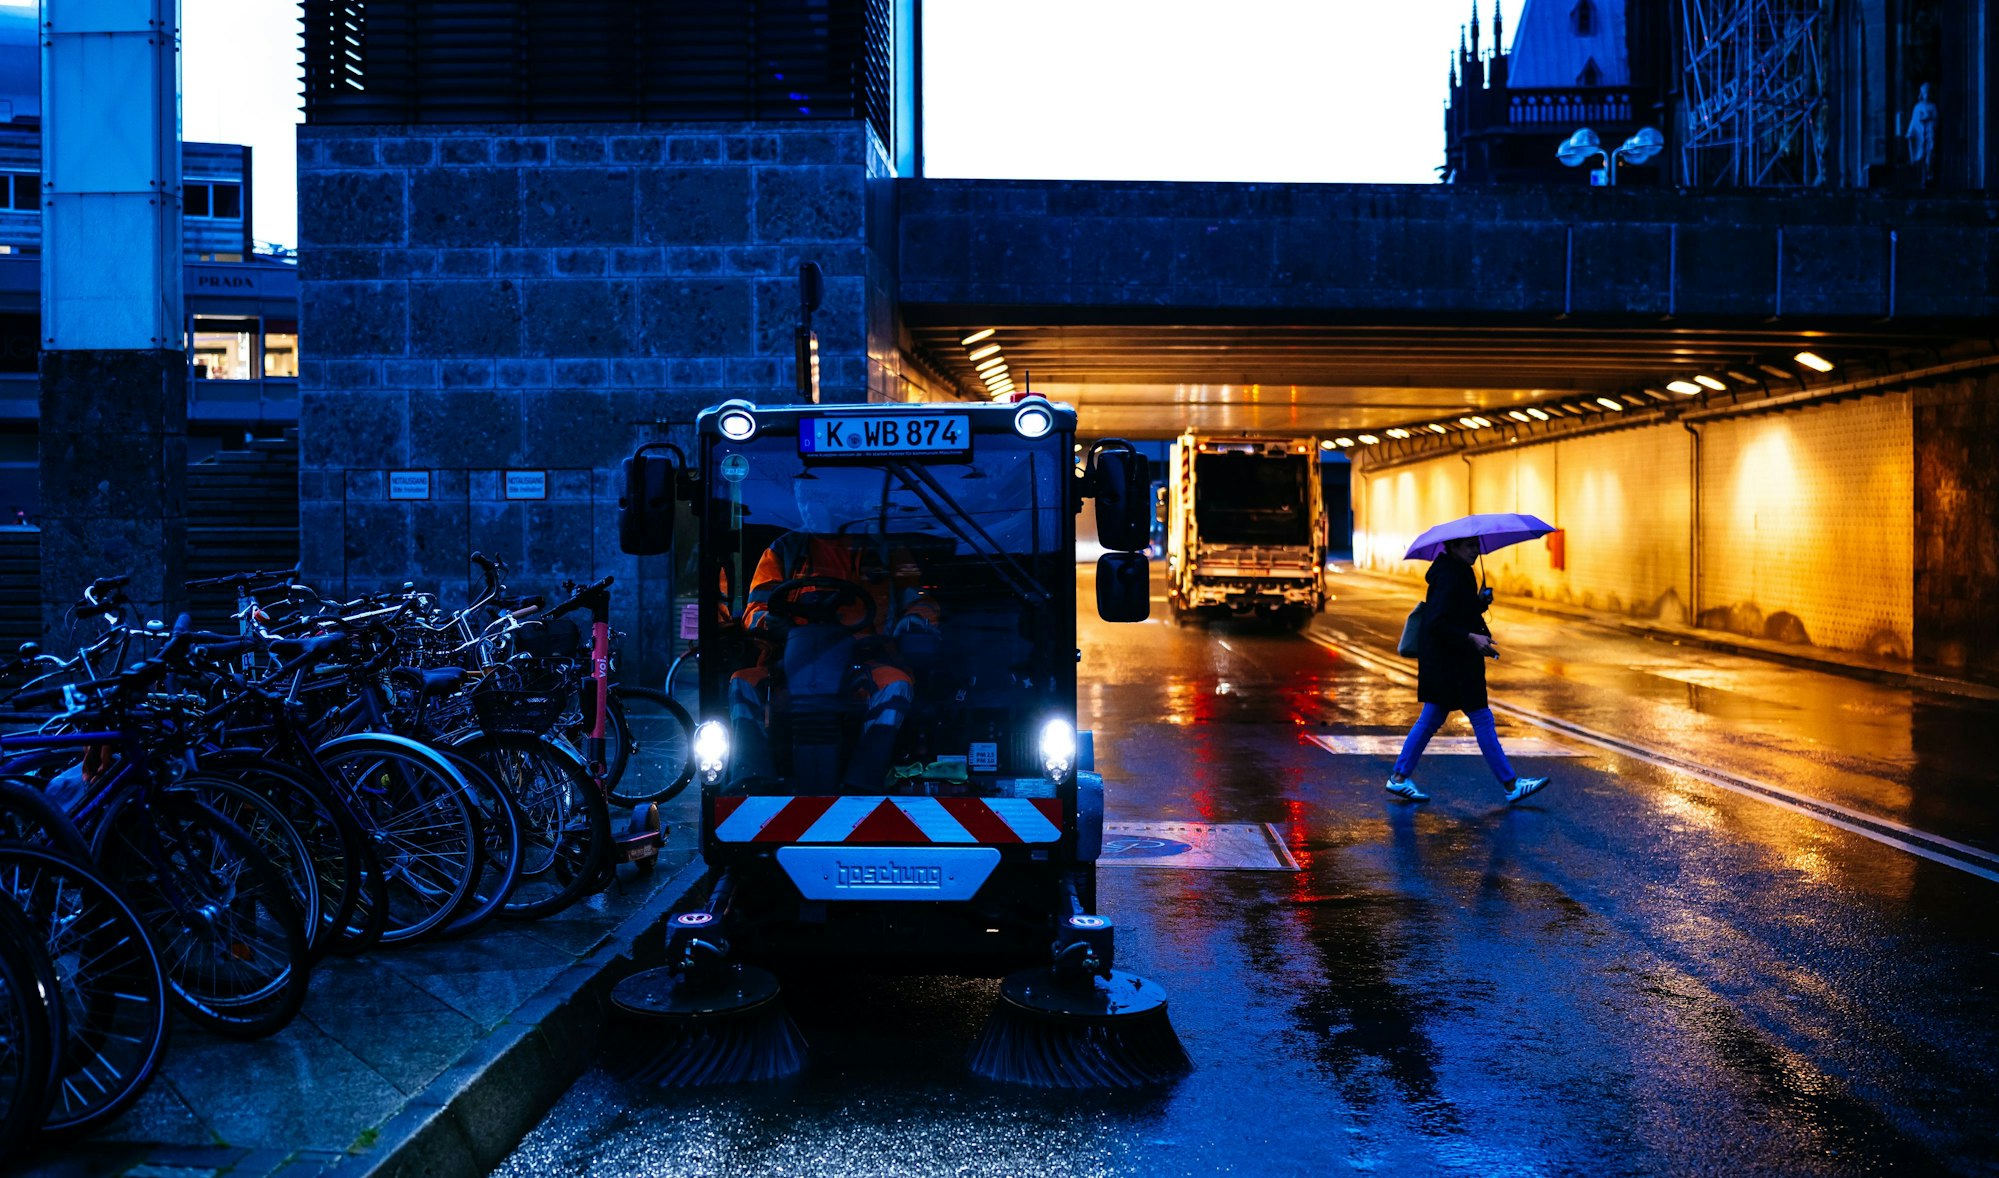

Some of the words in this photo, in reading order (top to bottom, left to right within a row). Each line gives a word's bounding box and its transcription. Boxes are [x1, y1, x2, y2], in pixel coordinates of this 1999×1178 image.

[199, 276, 254, 288] PRADA
[827, 421, 843, 447] K
[864, 420, 899, 447] WB
[907, 419, 957, 446] 874
[804, 439, 811, 447] D
